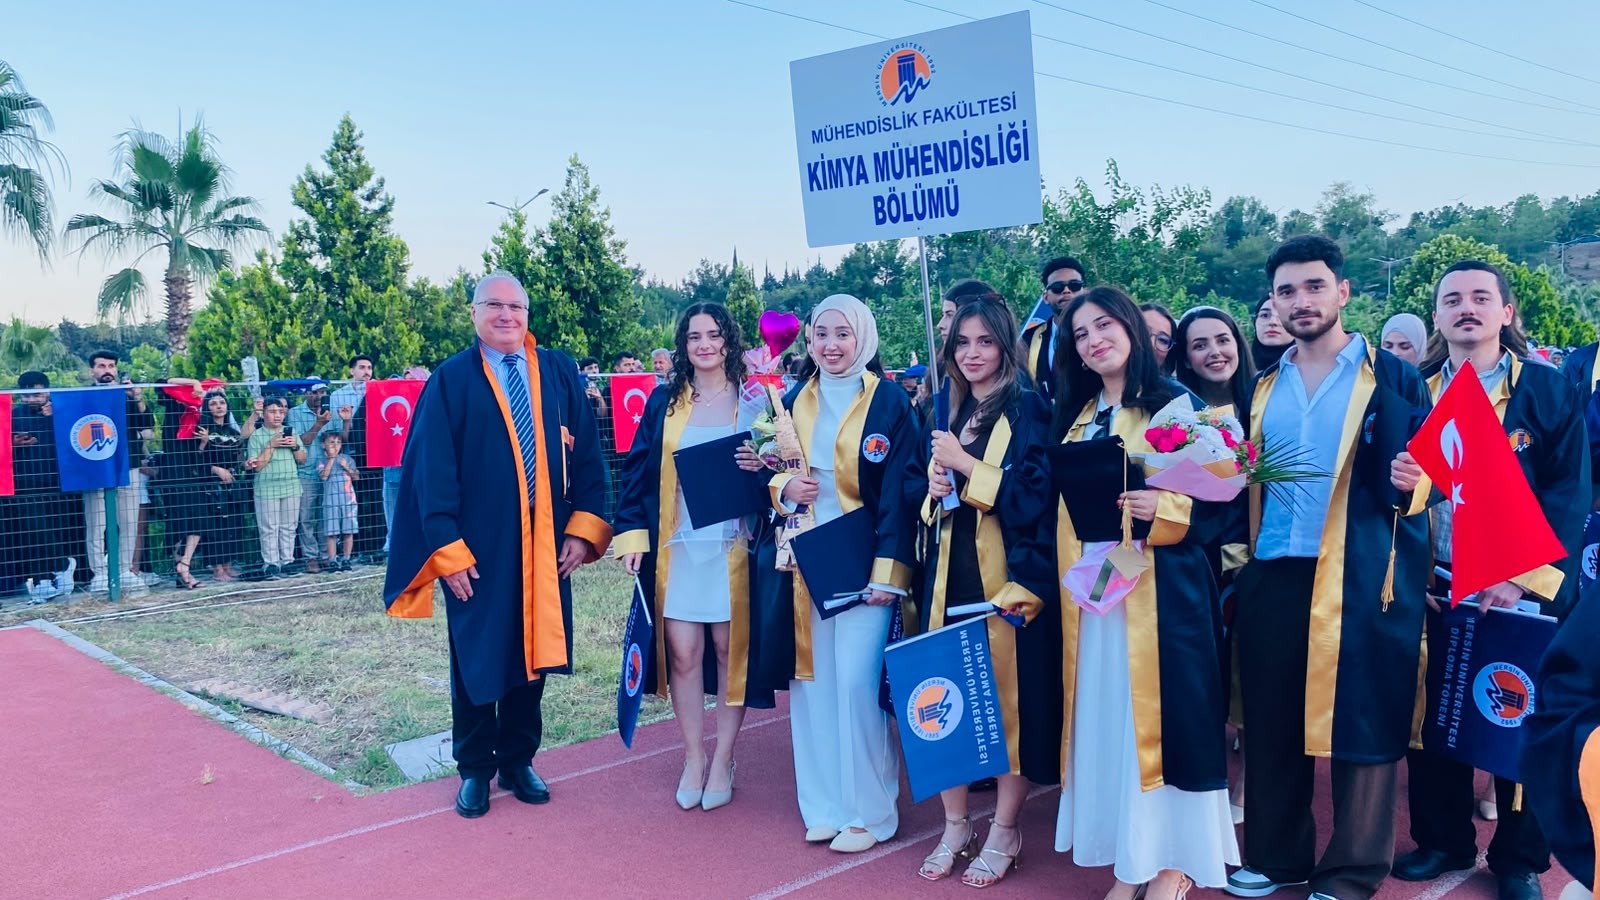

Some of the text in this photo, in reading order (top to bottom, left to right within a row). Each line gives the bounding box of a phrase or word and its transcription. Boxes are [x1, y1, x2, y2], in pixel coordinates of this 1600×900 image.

[811, 91, 1017, 145] MÜHENDİSLİK FAKÜLTESİ
[807, 119, 1030, 192] KİMYA MÜHENDİSLİĞİ
[873, 178, 960, 226] BÖLÜMÜ
